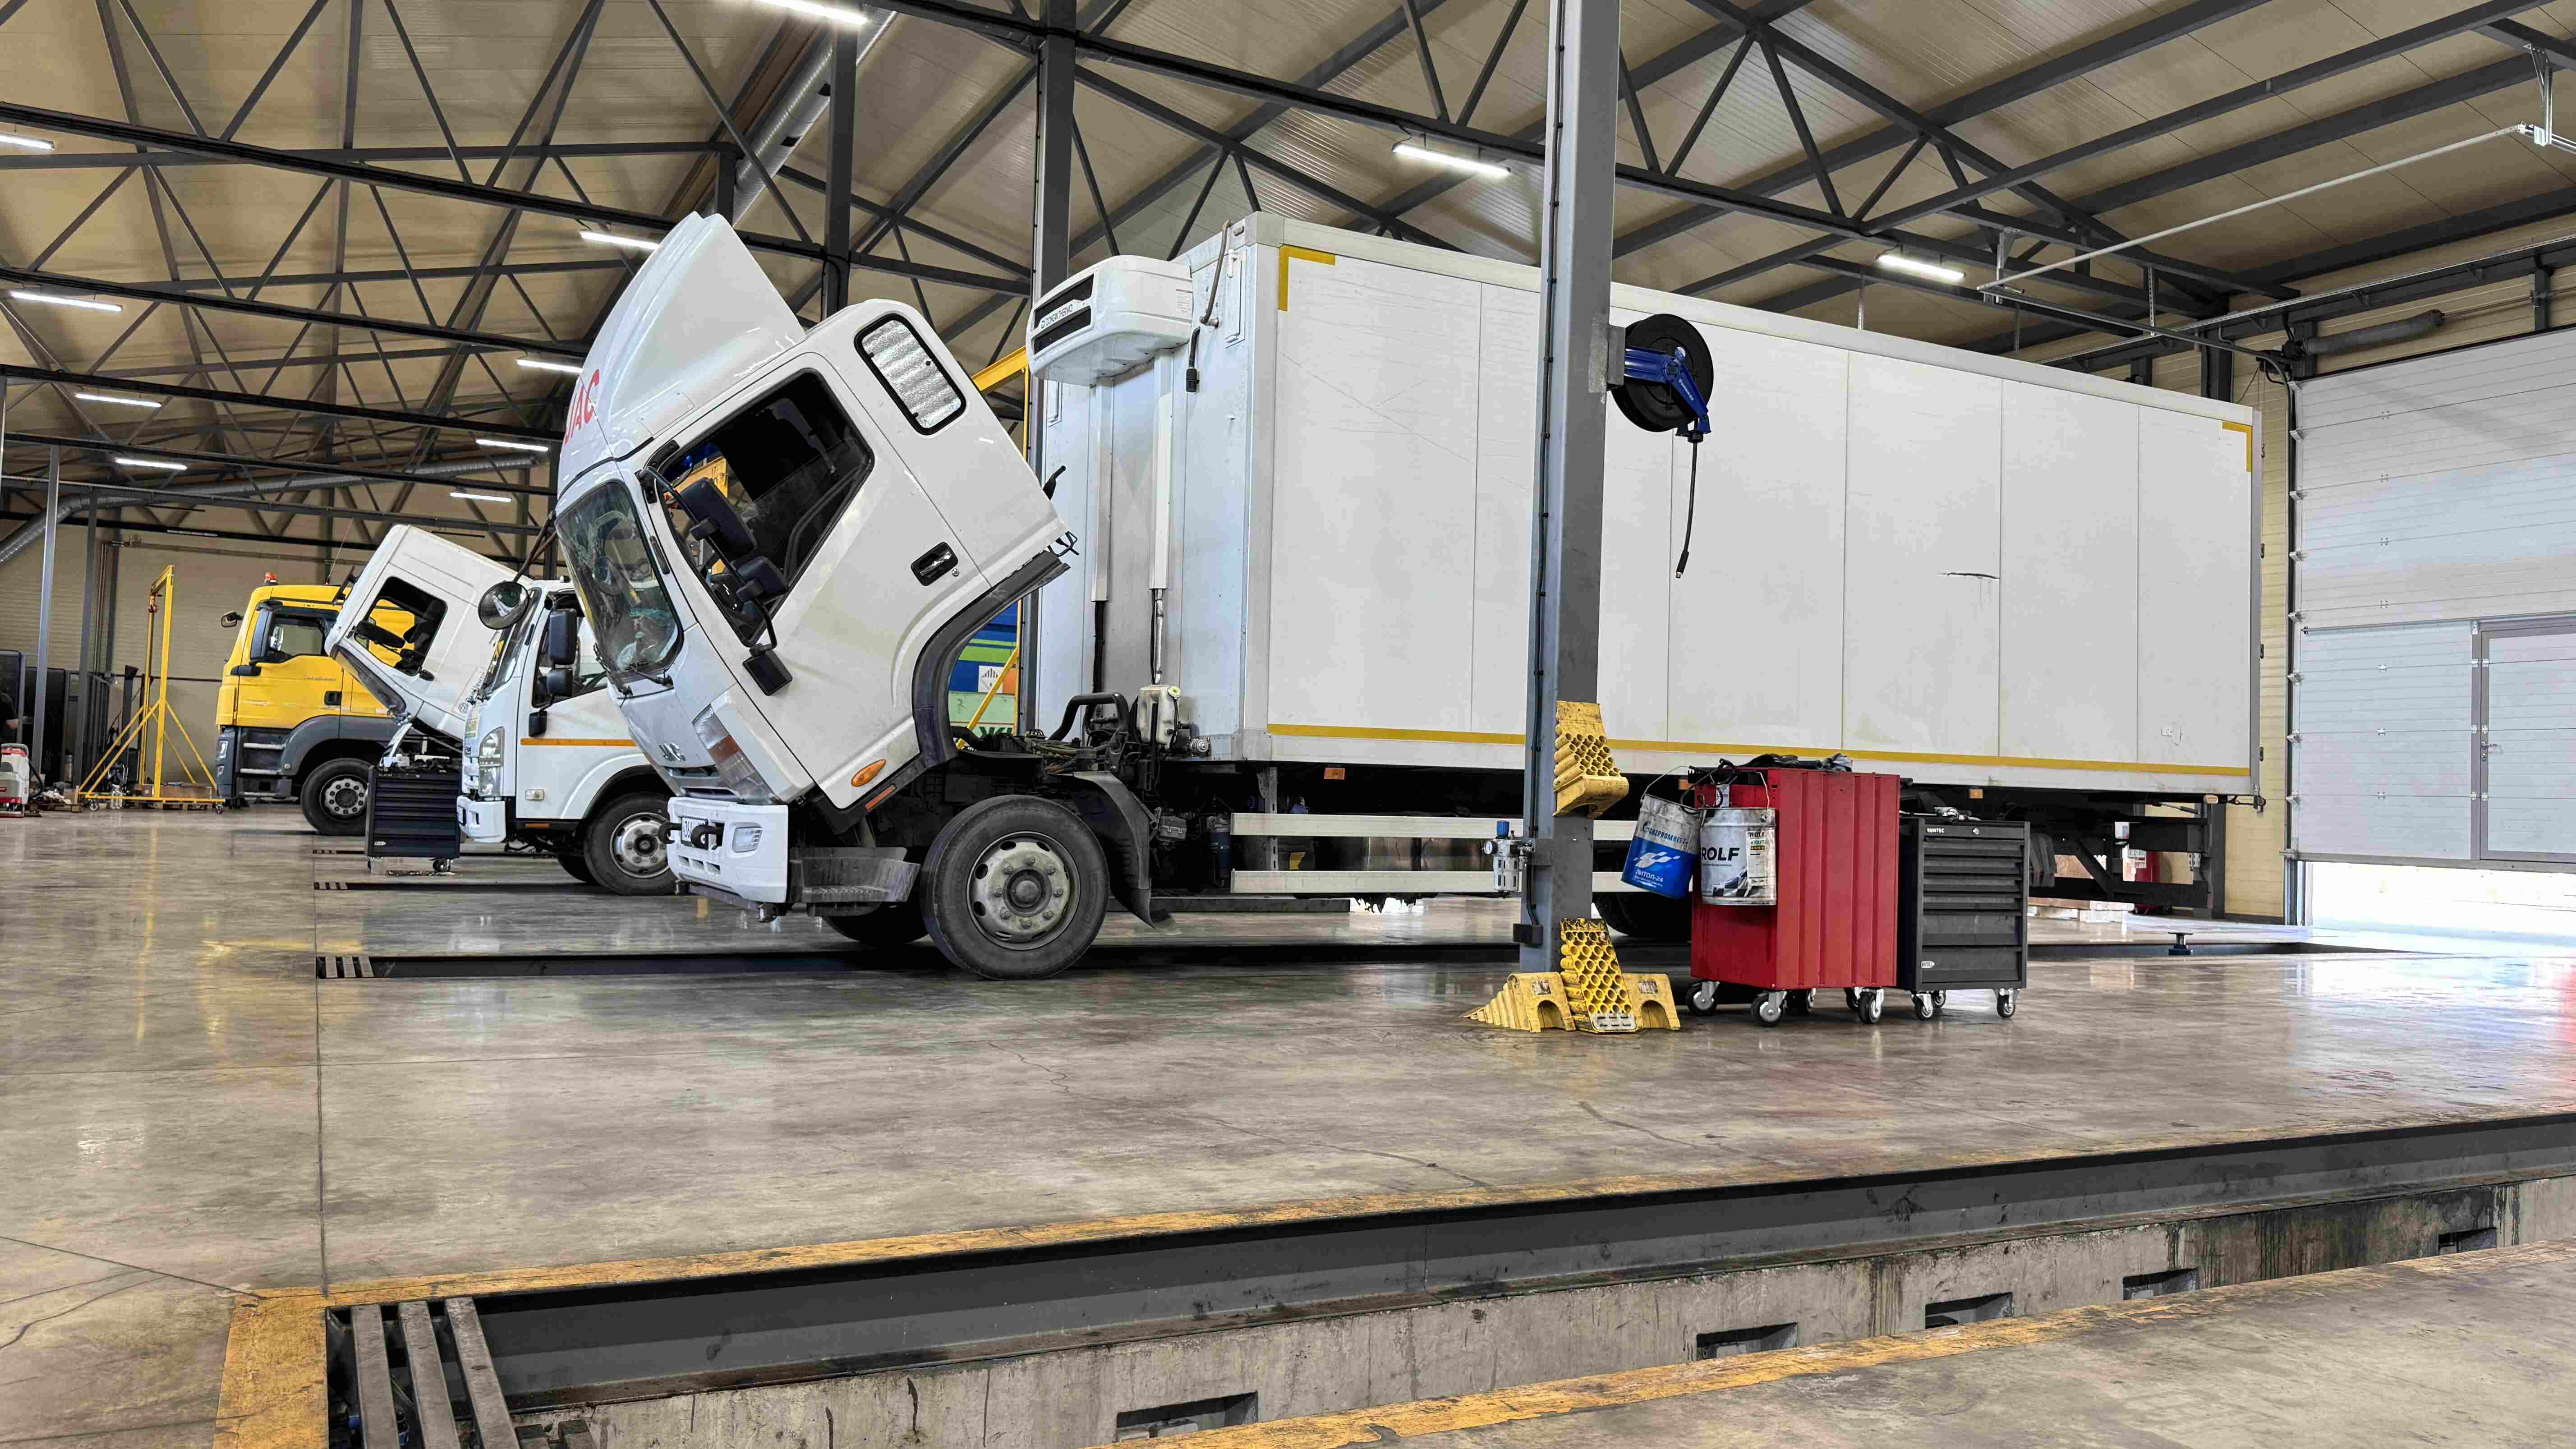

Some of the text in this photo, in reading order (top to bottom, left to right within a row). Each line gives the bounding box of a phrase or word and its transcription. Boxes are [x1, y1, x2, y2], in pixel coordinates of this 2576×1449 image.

[565, 368, 599, 446] JAC
[1702, 847, 1740, 860] ROLF
[1635, 869, 1664, 883] ЛИТОЛ-24
